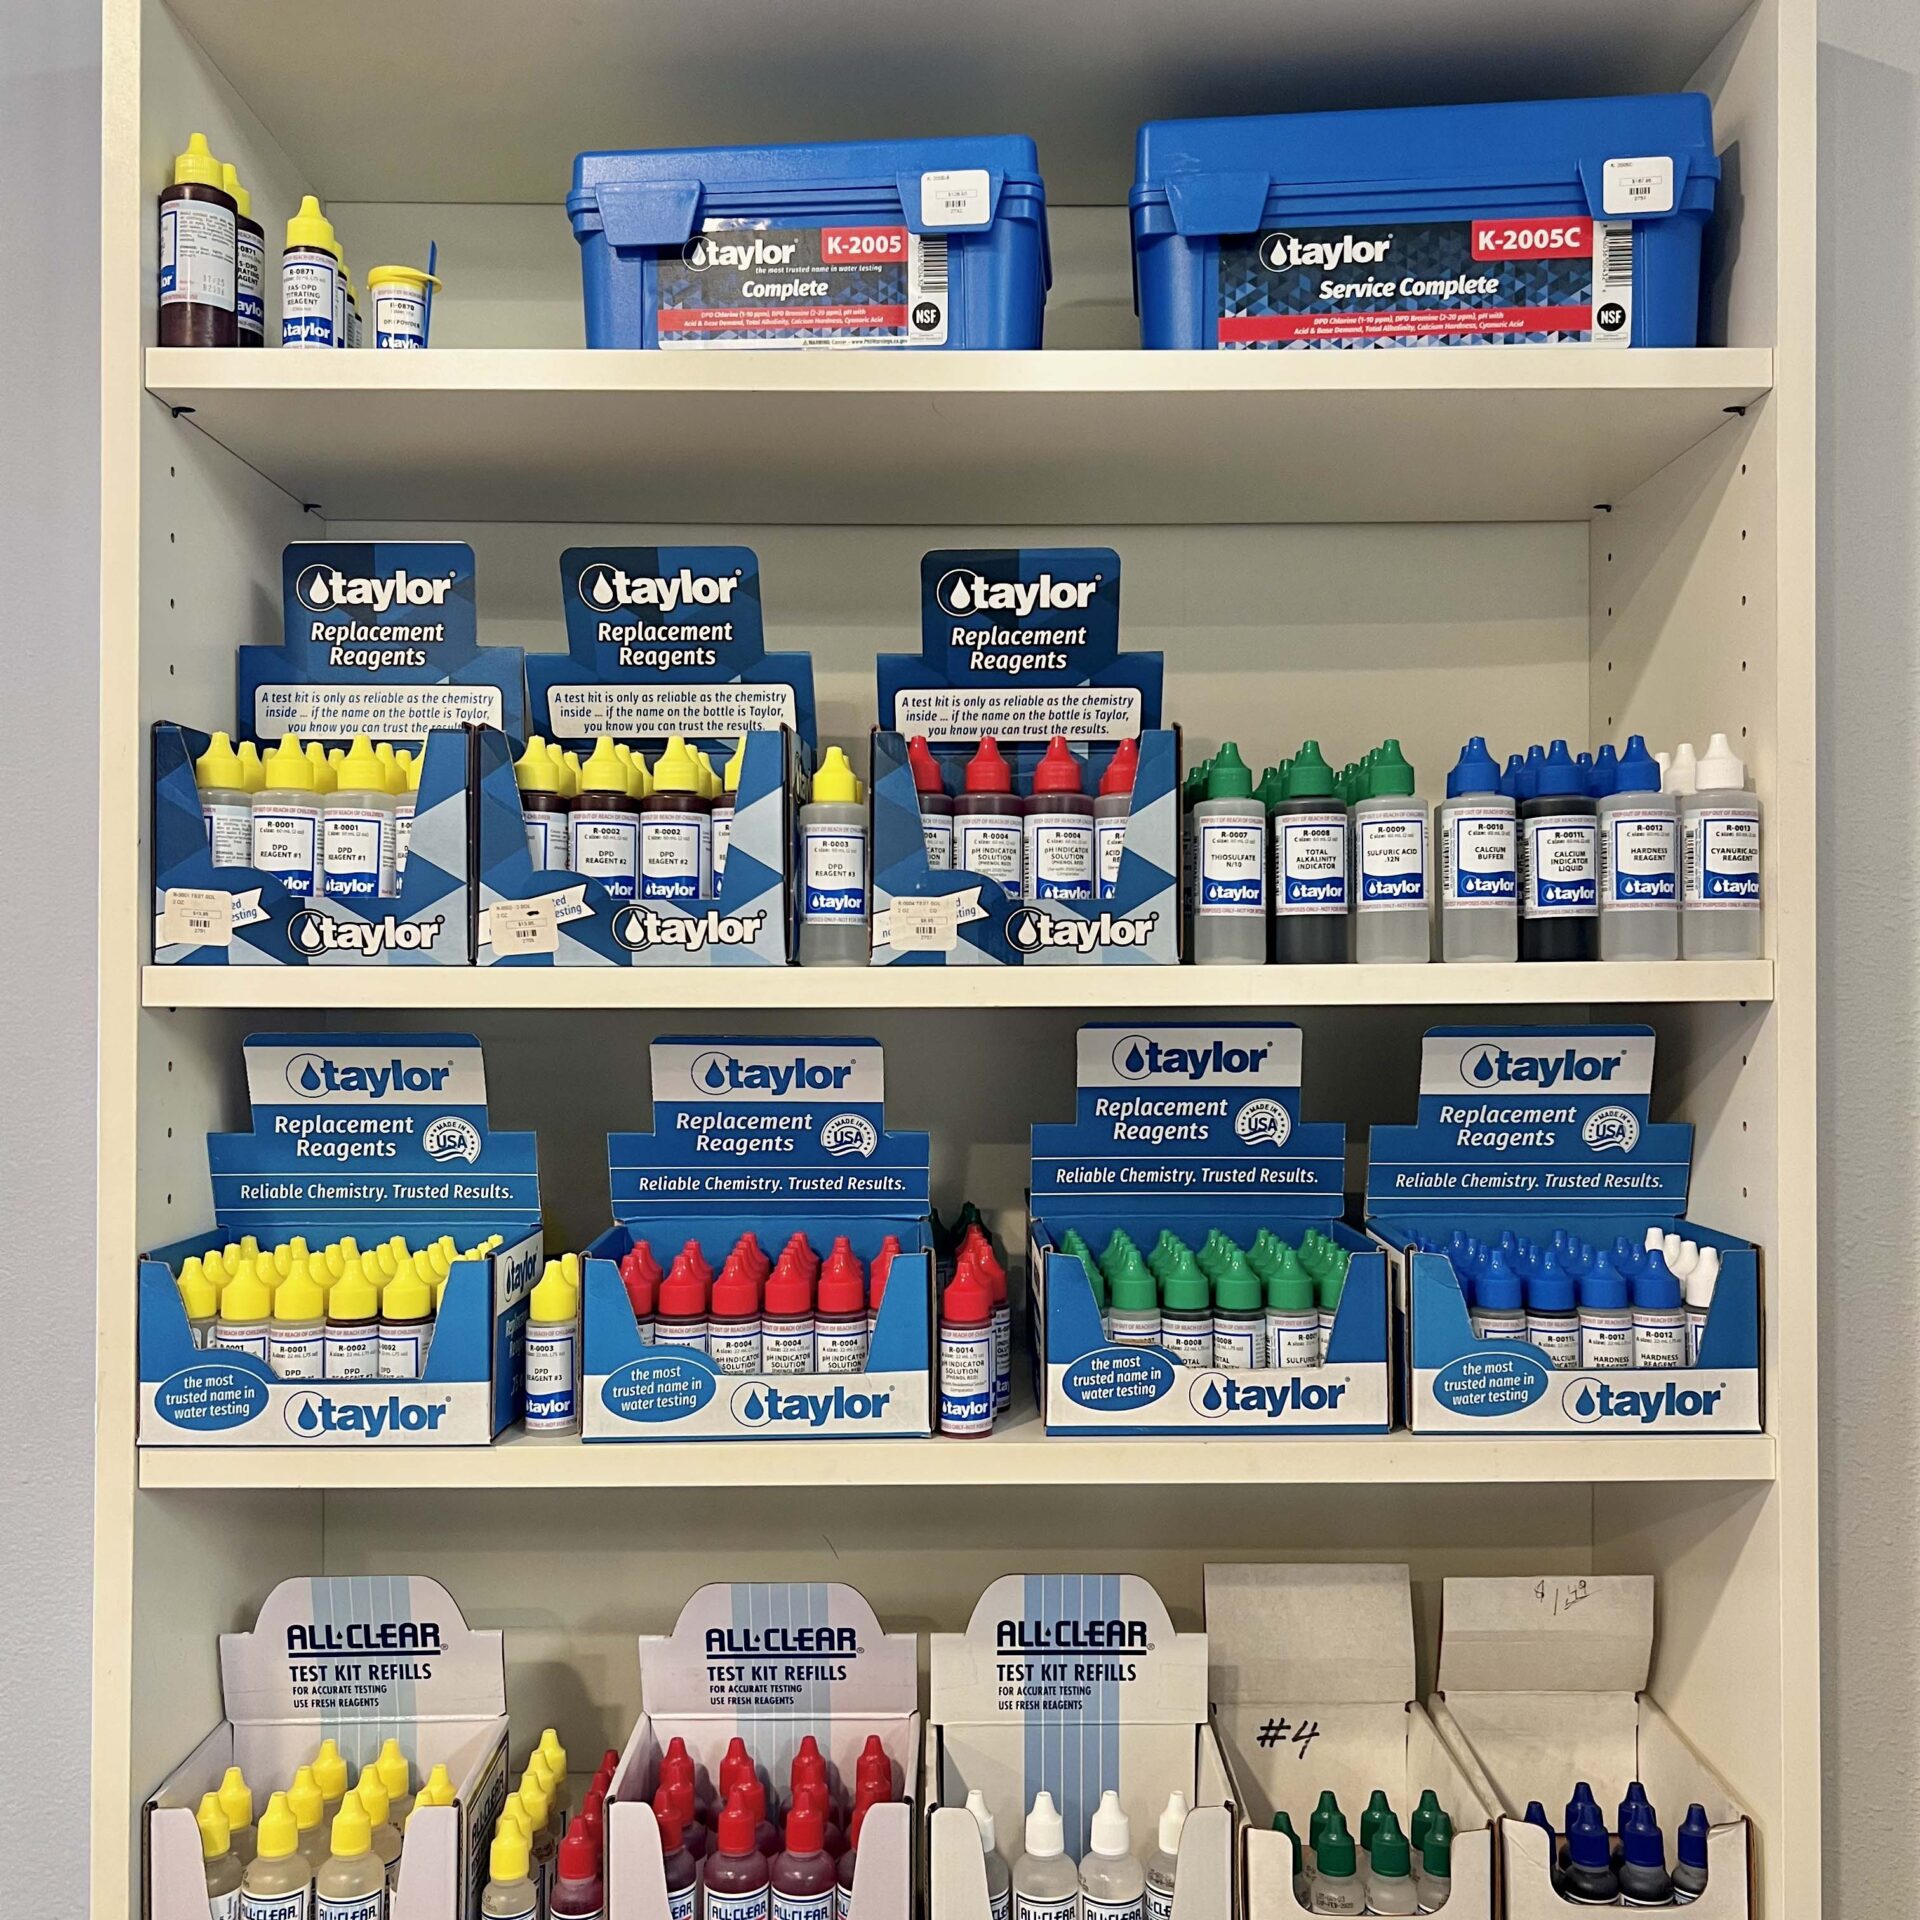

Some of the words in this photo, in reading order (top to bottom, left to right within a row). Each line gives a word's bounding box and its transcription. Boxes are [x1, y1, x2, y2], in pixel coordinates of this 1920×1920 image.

[828, 236, 901, 254] K-2005
[1478, 227, 1581, 250] K-2005C
[706, 240, 796, 270] taylor
[1288, 235, 1389, 270] taylor
[859, 264, 882, 272] testing
[742, 280, 829, 301] Complete
[1319, 276, 1395, 299] Service
[1400, 275, 1499, 299] Complete
[916, 309, 937, 324] NSF
[1601, 310, 1621, 324] NSF
[287, 323, 330, 338] taylor
[329, 571, 451, 611] taylor
[613, 569, 737, 611] taylor
[971, 575, 1096, 615] taylor
[311, 621, 444, 645] Replacement
[598, 622, 733, 645] Replacement
[952, 626, 1087, 649] Replacement
[330, 647, 426, 670] Reagents
[619, 648, 716, 670] Reagents
[970, 652, 1067, 673] Reagents
[902, 698, 909, 707] A
[912, 697, 931, 707] test
[934, 696, 950, 707] kit
[953, 696, 960, 706] is
[964, 695, 985, 708] only
[989, 698, 1001, 706] as
[1003, 695, 1044, 706] reliable
[1047, 697, 1058, 705] as
[1062, 695, 1078, 705] the
[1081, 694, 1134, 708] chemistry
[928, 726, 946, 737] you
[949, 724, 978, 735] know
[980, 726, 999, 736] you
[1002, 726, 1020, 734] can
[1023, 724, 1048, 734] trust
[1051, 724, 1068, 734] the
[1071, 723, 1109, 734] results.
[593, 827, 620, 835] R-0002
[1637, 824, 1663, 832] R-0012
[1726, 824, 1750, 832] R-0013
[822, 840, 848, 848] R-0003
[1367, 849, 1400, 857] SULFURIC
[293, 851, 301, 859] #1
[585, 857, 617, 865] REAGENT
[619, 857, 627, 865] #2
[1211, 854, 1256, 862] THIOSULFATE
[815, 869, 845, 878] REAGENT
[847, 870, 856, 878] #3
[329, 879, 374, 894] taylor
[1217, 885, 1259, 901] taylor
[1300, 884, 1342, 900] taylor
[1377, 880, 1420, 896] taylor
[819, 895, 862, 909] taylor
[320, 917, 439, 956] taylor
[644, 911, 761, 950] taylor
[1039, 913, 1154, 952] taylor
[1146, 1041, 1267, 1080] taylor
[1495, 1050, 1620, 1088] taylor
[320, 1060, 449, 1098] taylor
[726, 1058, 851, 1095] taylor
[1095, 1098, 1228, 1120] Replacement
[1440, 1105, 1577, 1127] Replacement
[275, 1116, 414, 1137] Replacement
[676, 1113, 813, 1134] Replacement
[1114, 1122, 1209, 1144] Reagents
[296, 1139, 396, 1161] Reagents
[696, 1135, 794, 1155] Reagents
[1457, 1129, 1555, 1150] Reagents
[241, 1184, 303, 1200] Reliable
[307, 1184, 388, 1202] Chemistry.
[394, 1184, 449, 1200] Trusted
[454, 1185, 514, 1200] Results.
[511, 1251, 537, 1293] taylor
[184, 1377, 201, 1388] the
[204, 1376, 233, 1387] most
[166, 1392, 207, 1406] trusted
[210, 1390, 242, 1402] name
[245, 1387, 254, 1398] in
[765, 1386, 890, 1426] taylor
[1224, 1378, 1345, 1417] taylor
[1597, 1383, 1721, 1423] taylor
[174, 1406, 208, 1419] water
[210, 1404, 250, 1418] testing
[319, 1396, 446, 1438] taylor
[290, 1665, 327, 1681] TEST
[335, 1665, 361, 1680] KIT
[369, 1663, 431, 1680] REFILLS
[707, 1666, 745, 1681] TEST
[752, 1666, 777, 1680] KIT
[785, 1665, 847, 1680] REFILLS
[997, 1664, 1034, 1681] TEST
[1042, 1664, 1067, 1681] KIT
[1075, 1664, 1136, 1681] REFILLS
[999, 1686, 1014, 1696] FOR
[1017, 1686, 1056, 1696] ACCURATE
[1060, 1686, 1091, 1696] TESTING
[999, 1700, 1013, 1710] USE
[1016, 1700, 1039, 1710] FRESH
[1043, 1700, 1083, 1710] REAGENTS
[1257, 1717, 1320, 1759] #4
